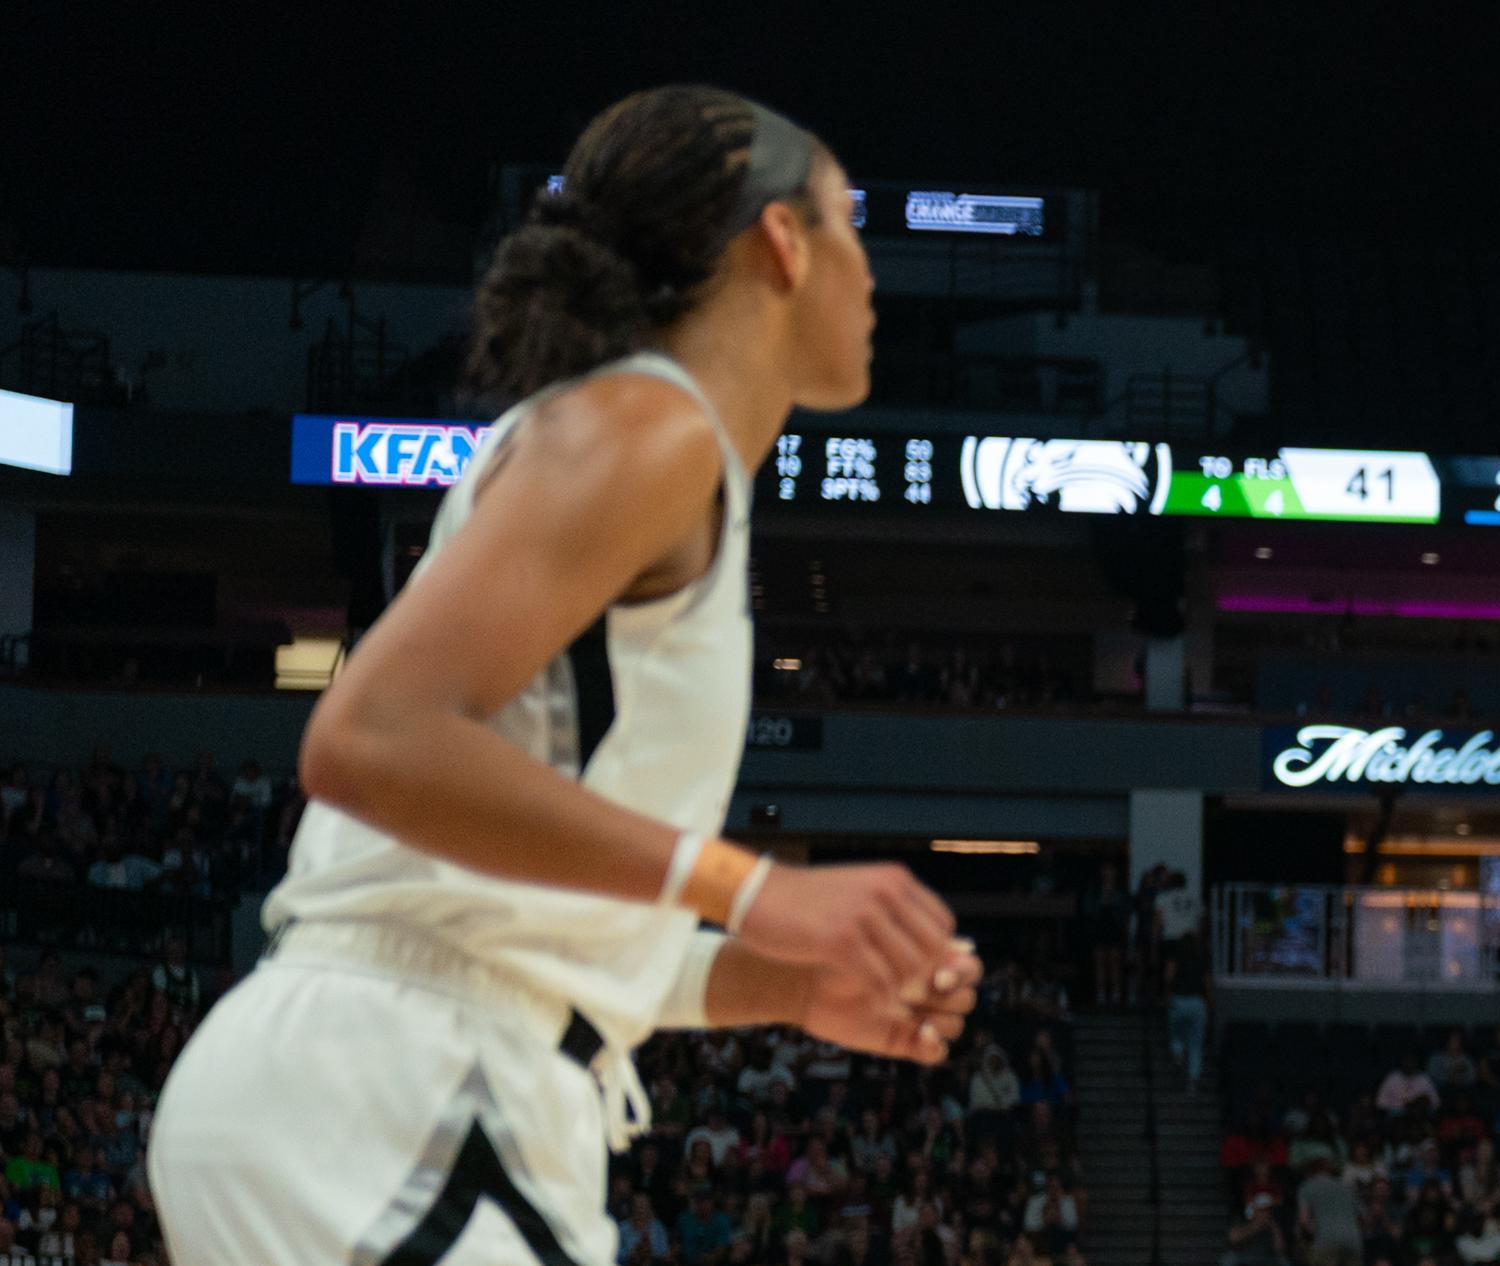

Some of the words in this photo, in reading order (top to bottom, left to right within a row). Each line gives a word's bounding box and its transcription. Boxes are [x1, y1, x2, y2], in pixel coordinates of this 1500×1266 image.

[1199, 456, 1233, 479] TO
[1243, 458, 1287, 481] FLS
[1201, 484, 1222, 512] 4
[1344, 465, 1396, 503] 41
